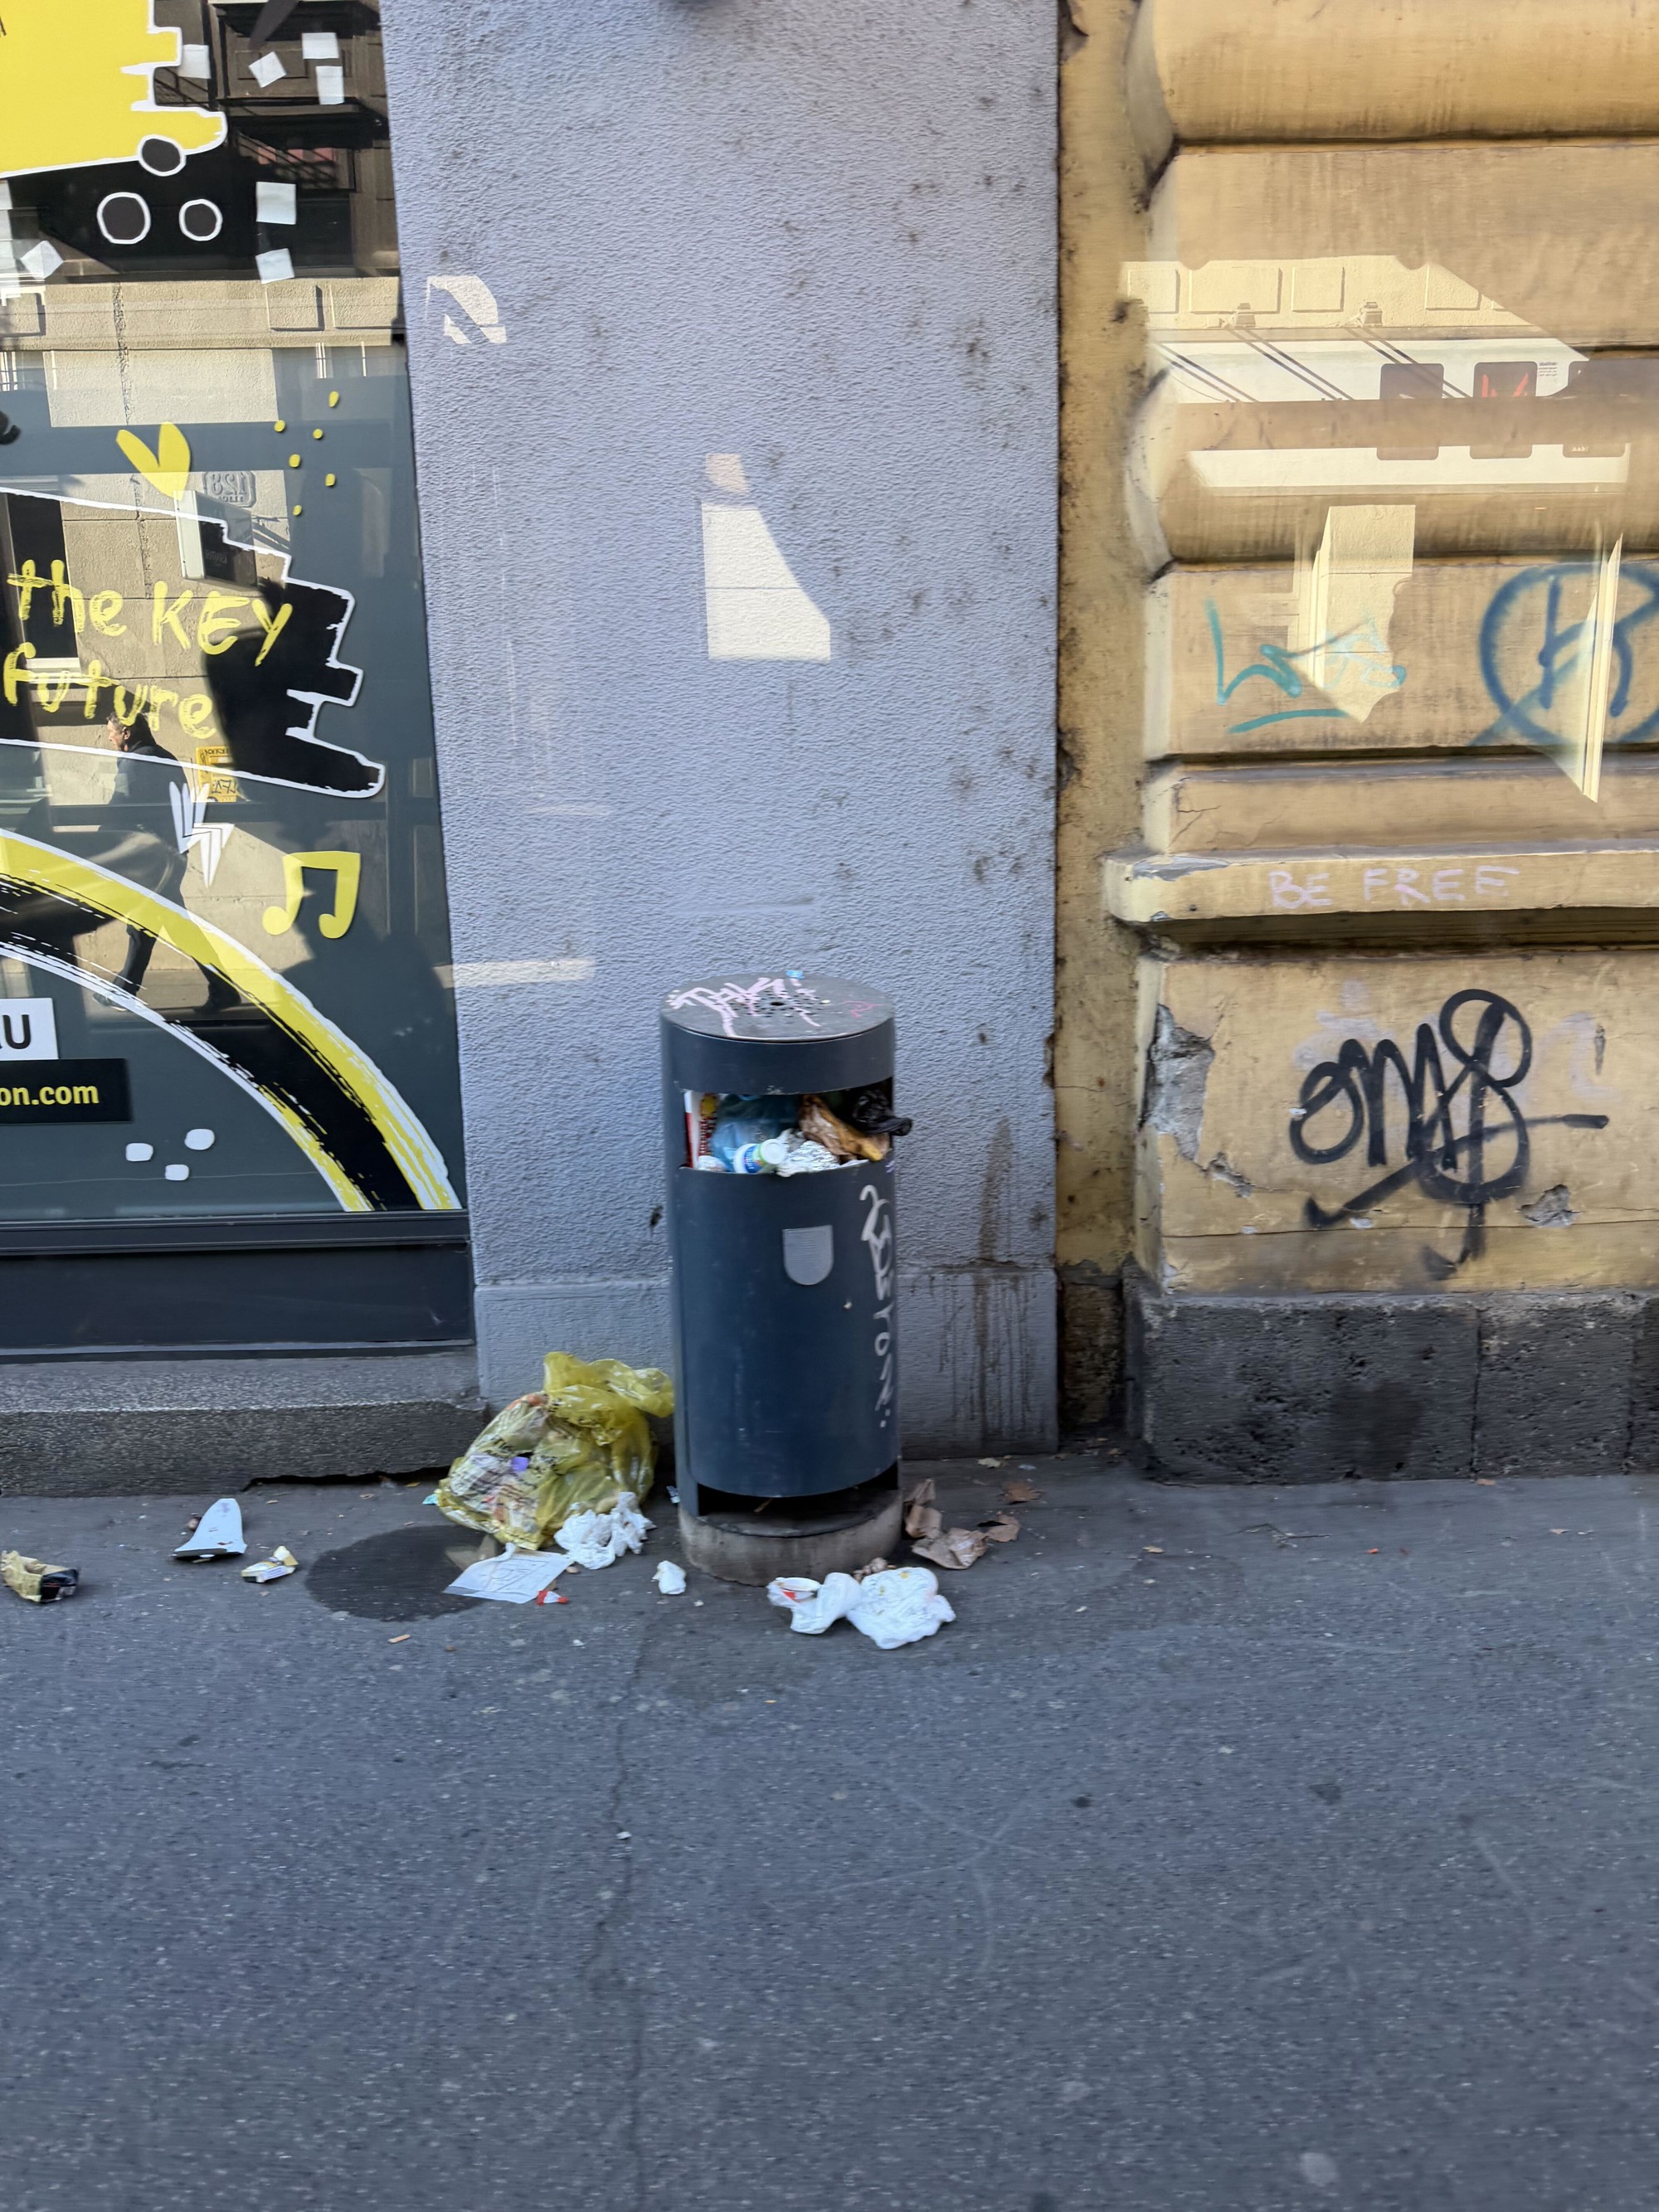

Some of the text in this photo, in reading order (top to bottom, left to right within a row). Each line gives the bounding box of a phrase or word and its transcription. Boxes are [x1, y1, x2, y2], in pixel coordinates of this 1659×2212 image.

[7, 559, 128, 637] the
[3, 643, 216, 739] future
[1269, 866, 1520, 908] BE FREE
